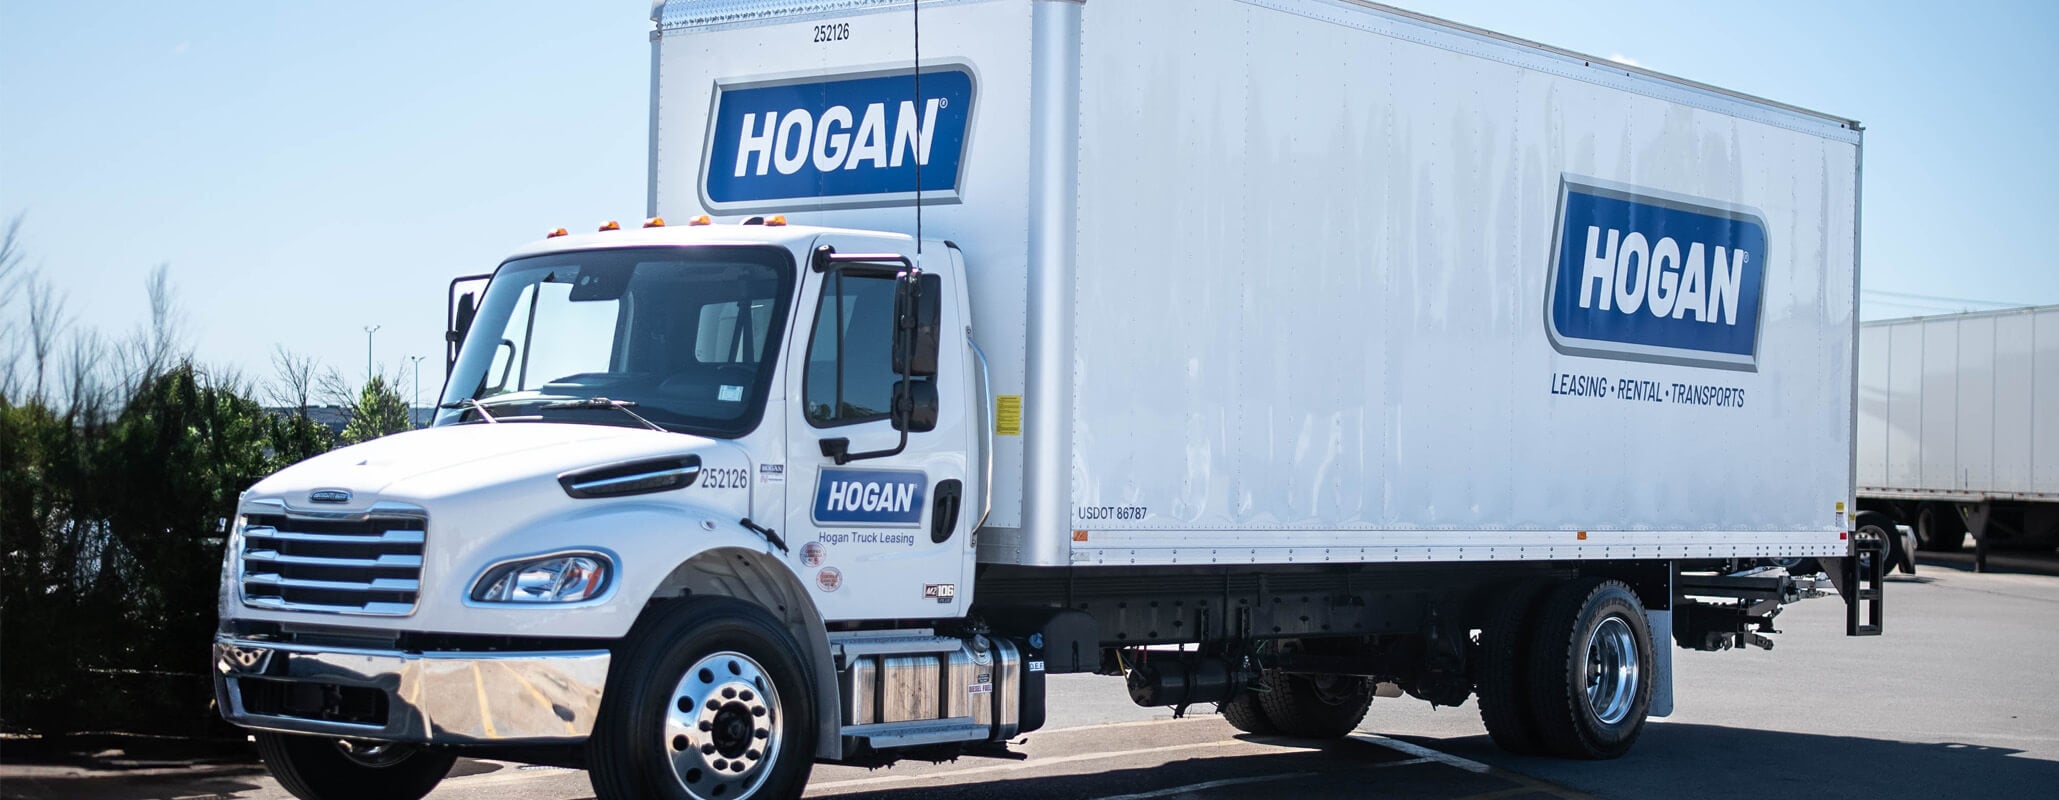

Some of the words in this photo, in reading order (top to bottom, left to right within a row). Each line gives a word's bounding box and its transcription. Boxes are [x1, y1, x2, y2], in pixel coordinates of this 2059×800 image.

[814, 23, 850, 43] 252126
[1551, 373, 1607, 398] LEASING
[1617, 379, 1663, 402] RENTAL
[1671, 383, 1745, 408] TRANSPORTS
[701, 468, 747, 488] 252126
[1078, 506, 1115, 520] USDOT
[1116, 506, 1147, 520] 86787
[819, 532, 849, 545] Hogan
[851, 532, 878, 543] Truck
[880, 532, 914, 546] Leasing
[938, 585, 954, 597] 106
